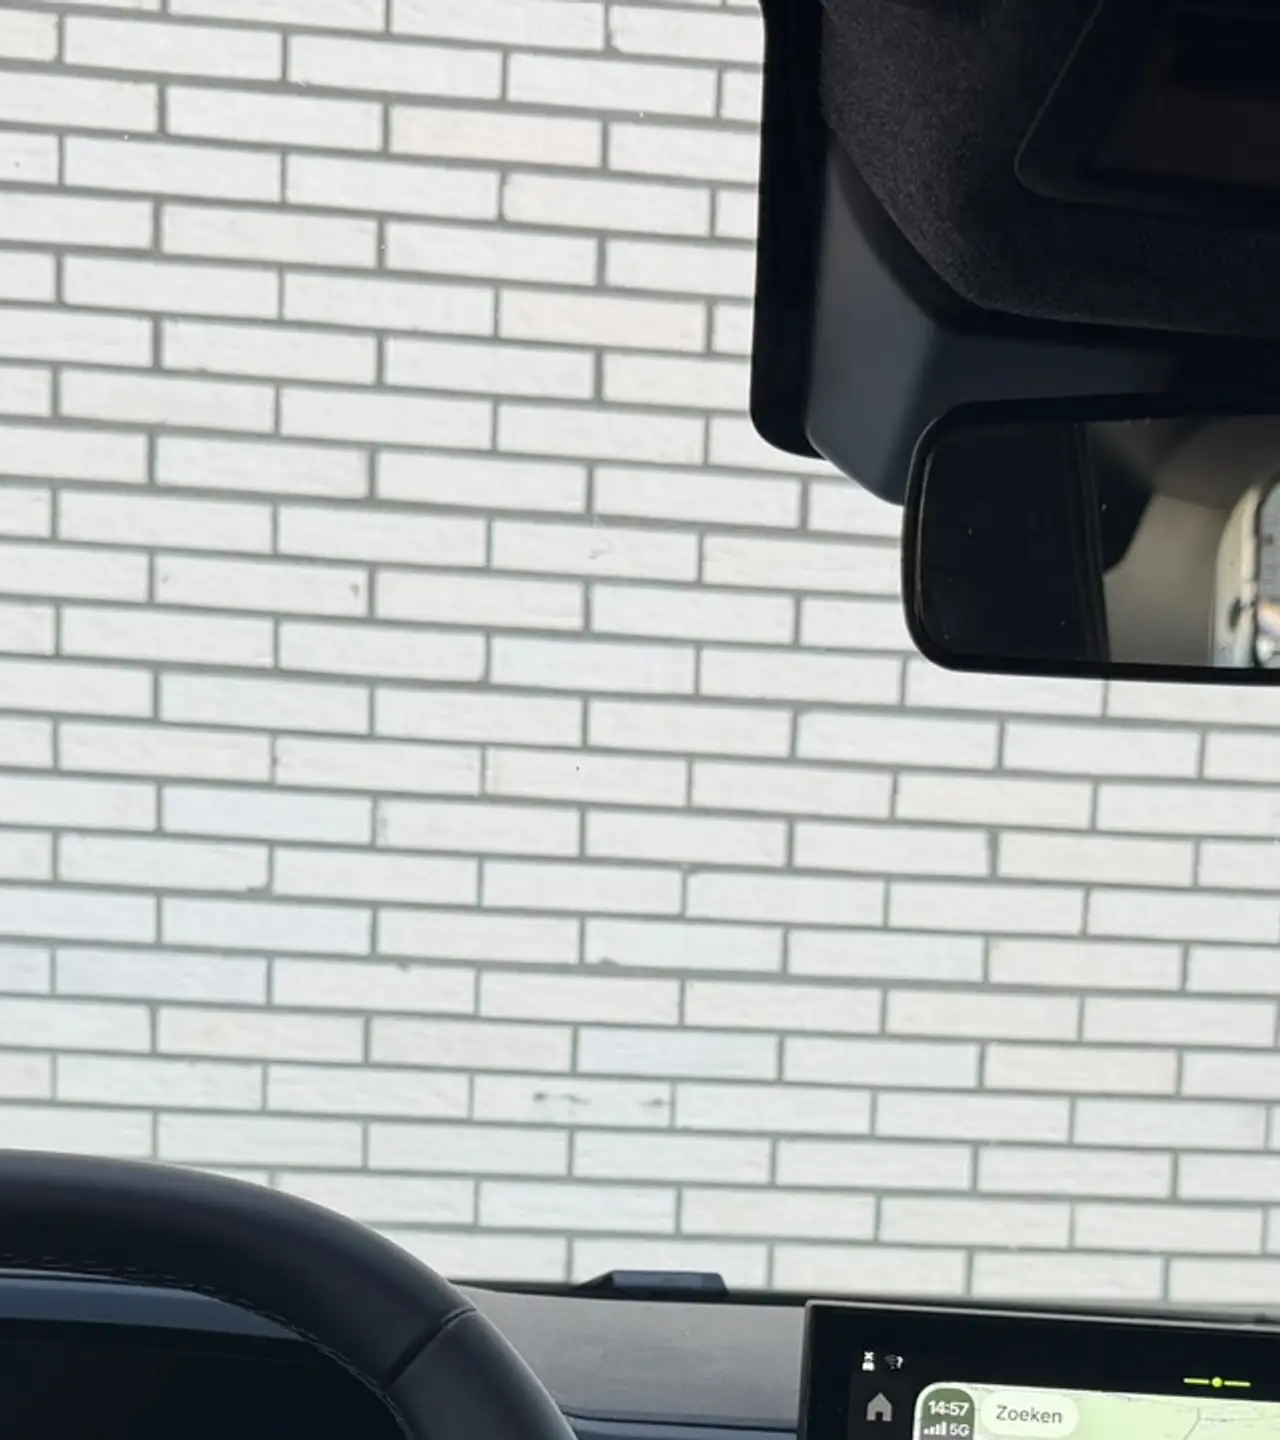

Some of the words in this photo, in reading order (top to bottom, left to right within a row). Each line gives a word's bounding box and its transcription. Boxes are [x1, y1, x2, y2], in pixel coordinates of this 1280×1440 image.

[928, 1400, 969, 1417] 14:57
[995, 1404, 1063, 1425] Zoeken
[949, 1423, 970, 1437] 5G
